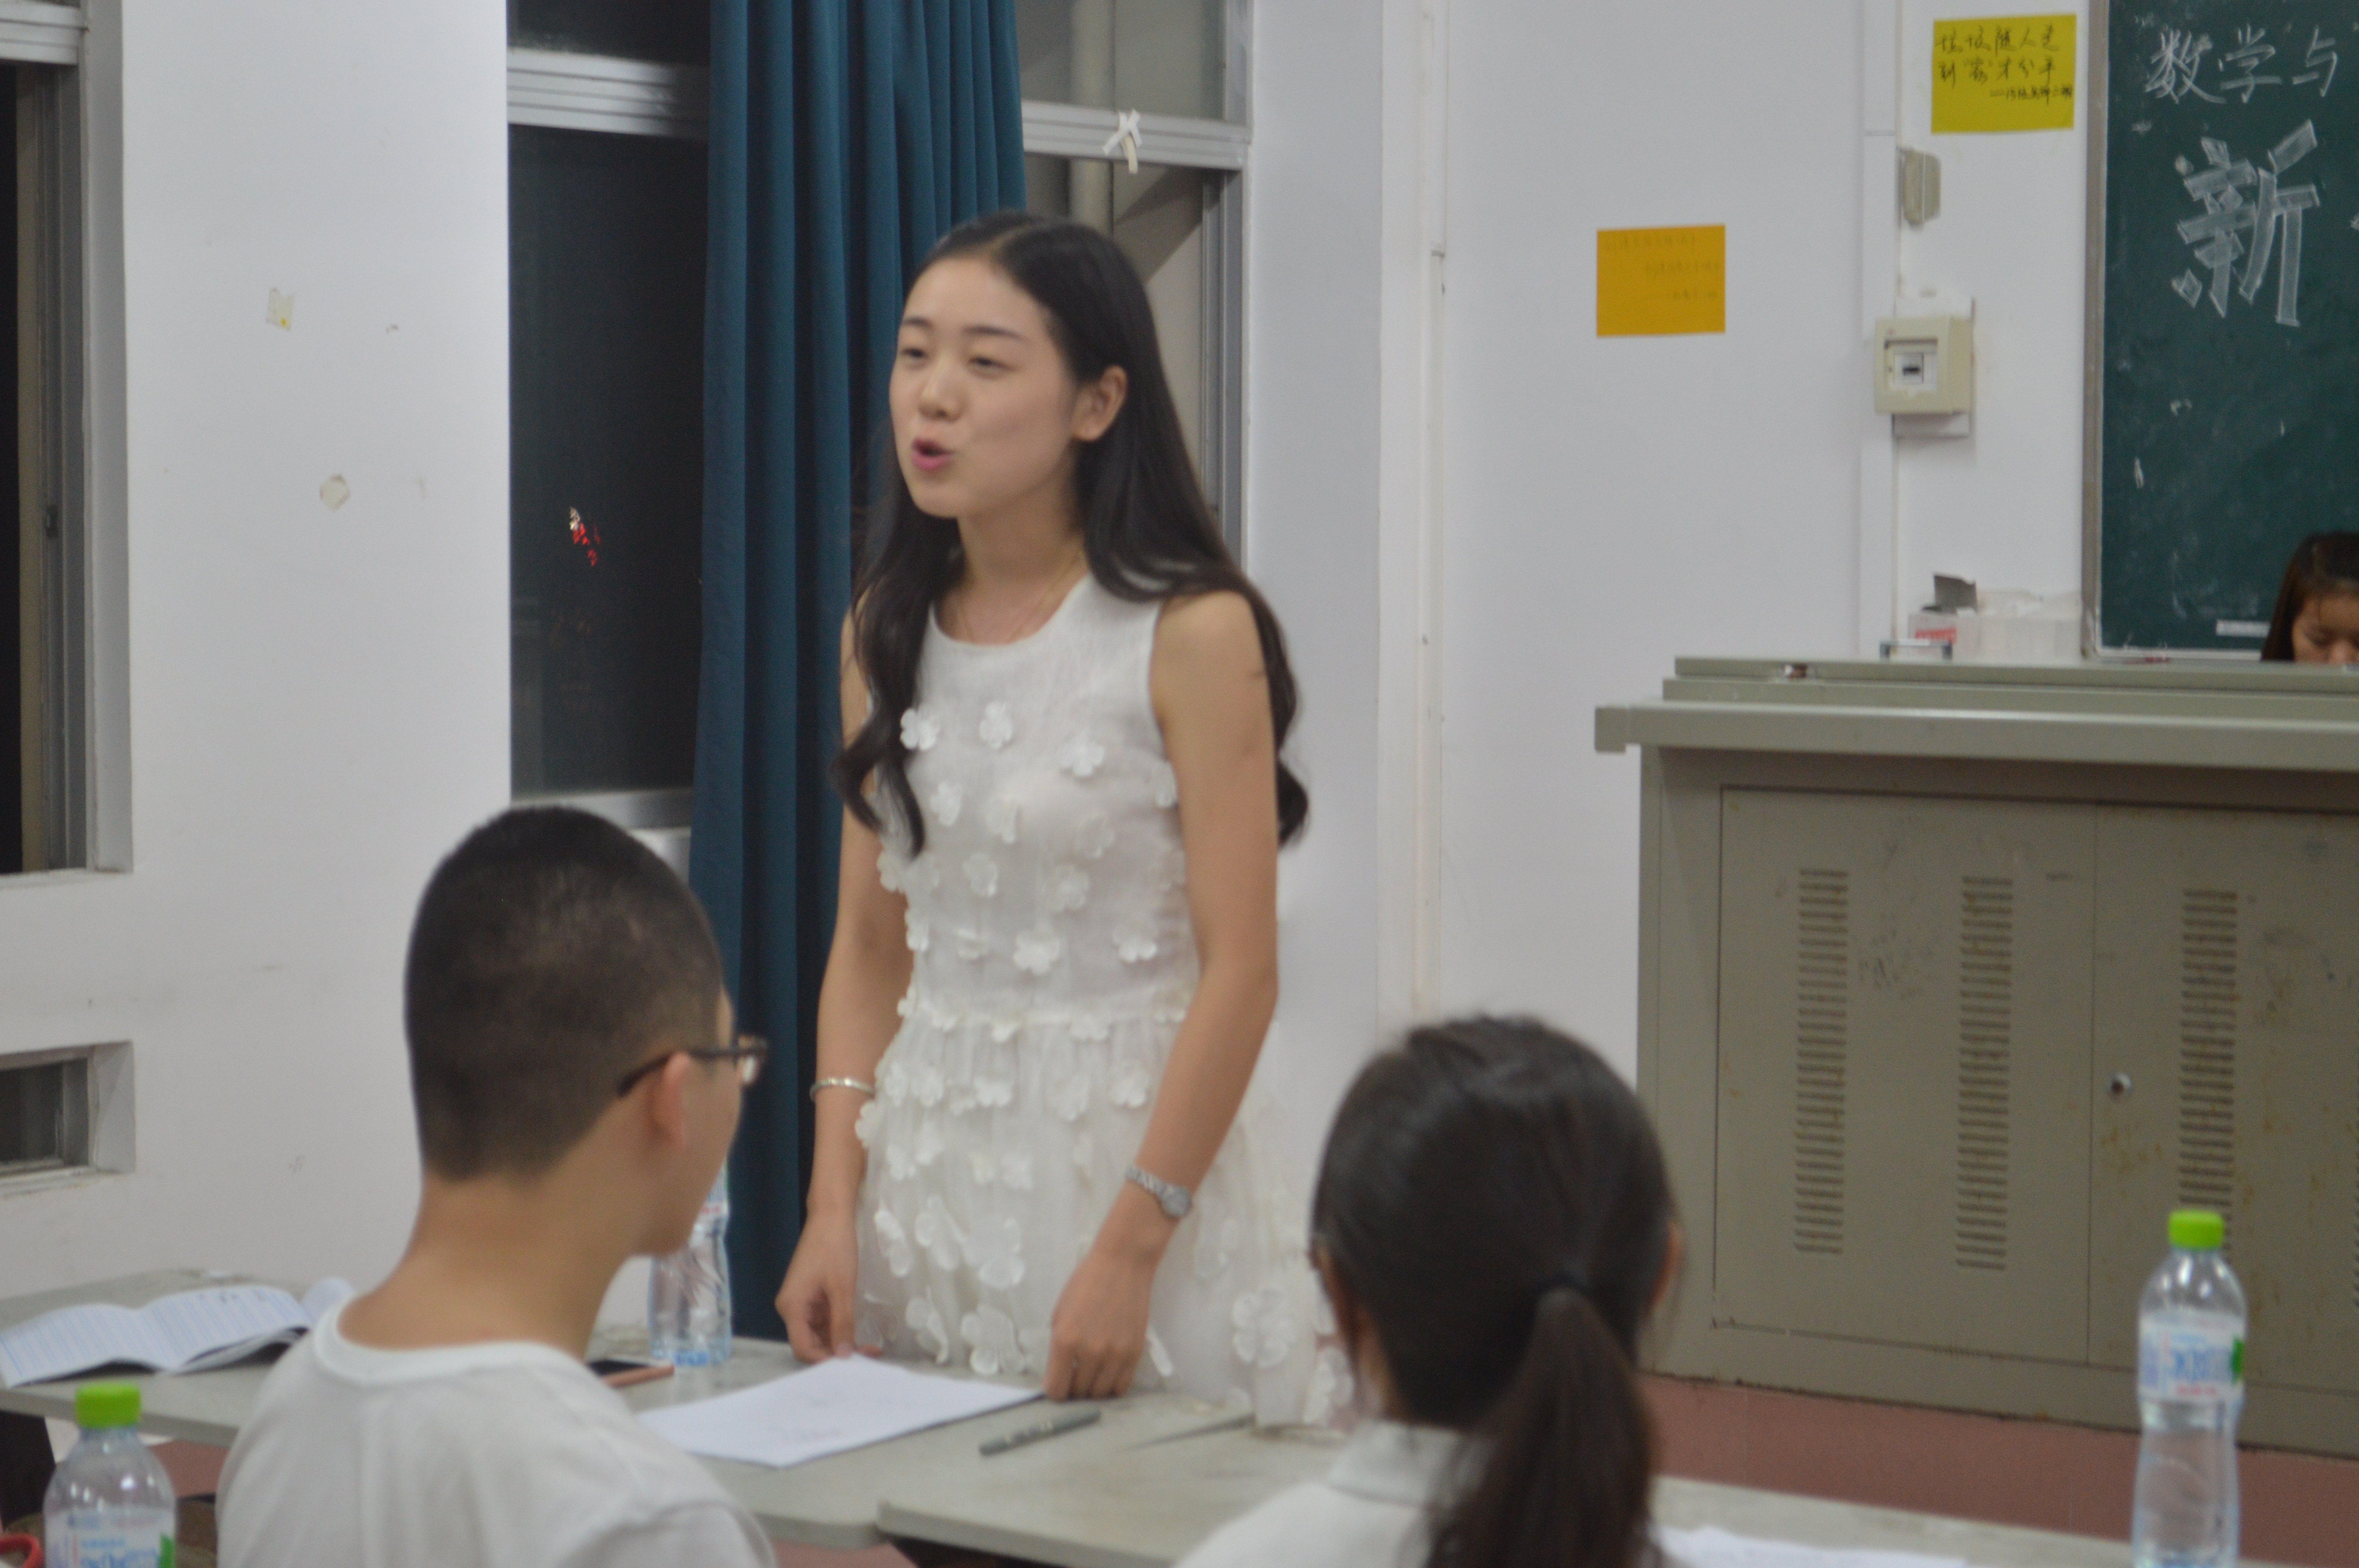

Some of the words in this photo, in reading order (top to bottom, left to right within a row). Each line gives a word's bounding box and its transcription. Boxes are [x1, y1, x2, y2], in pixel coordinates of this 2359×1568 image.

[2145, 24, 2337, 104] 数学与
[2171, 119, 2321, 327] 新
